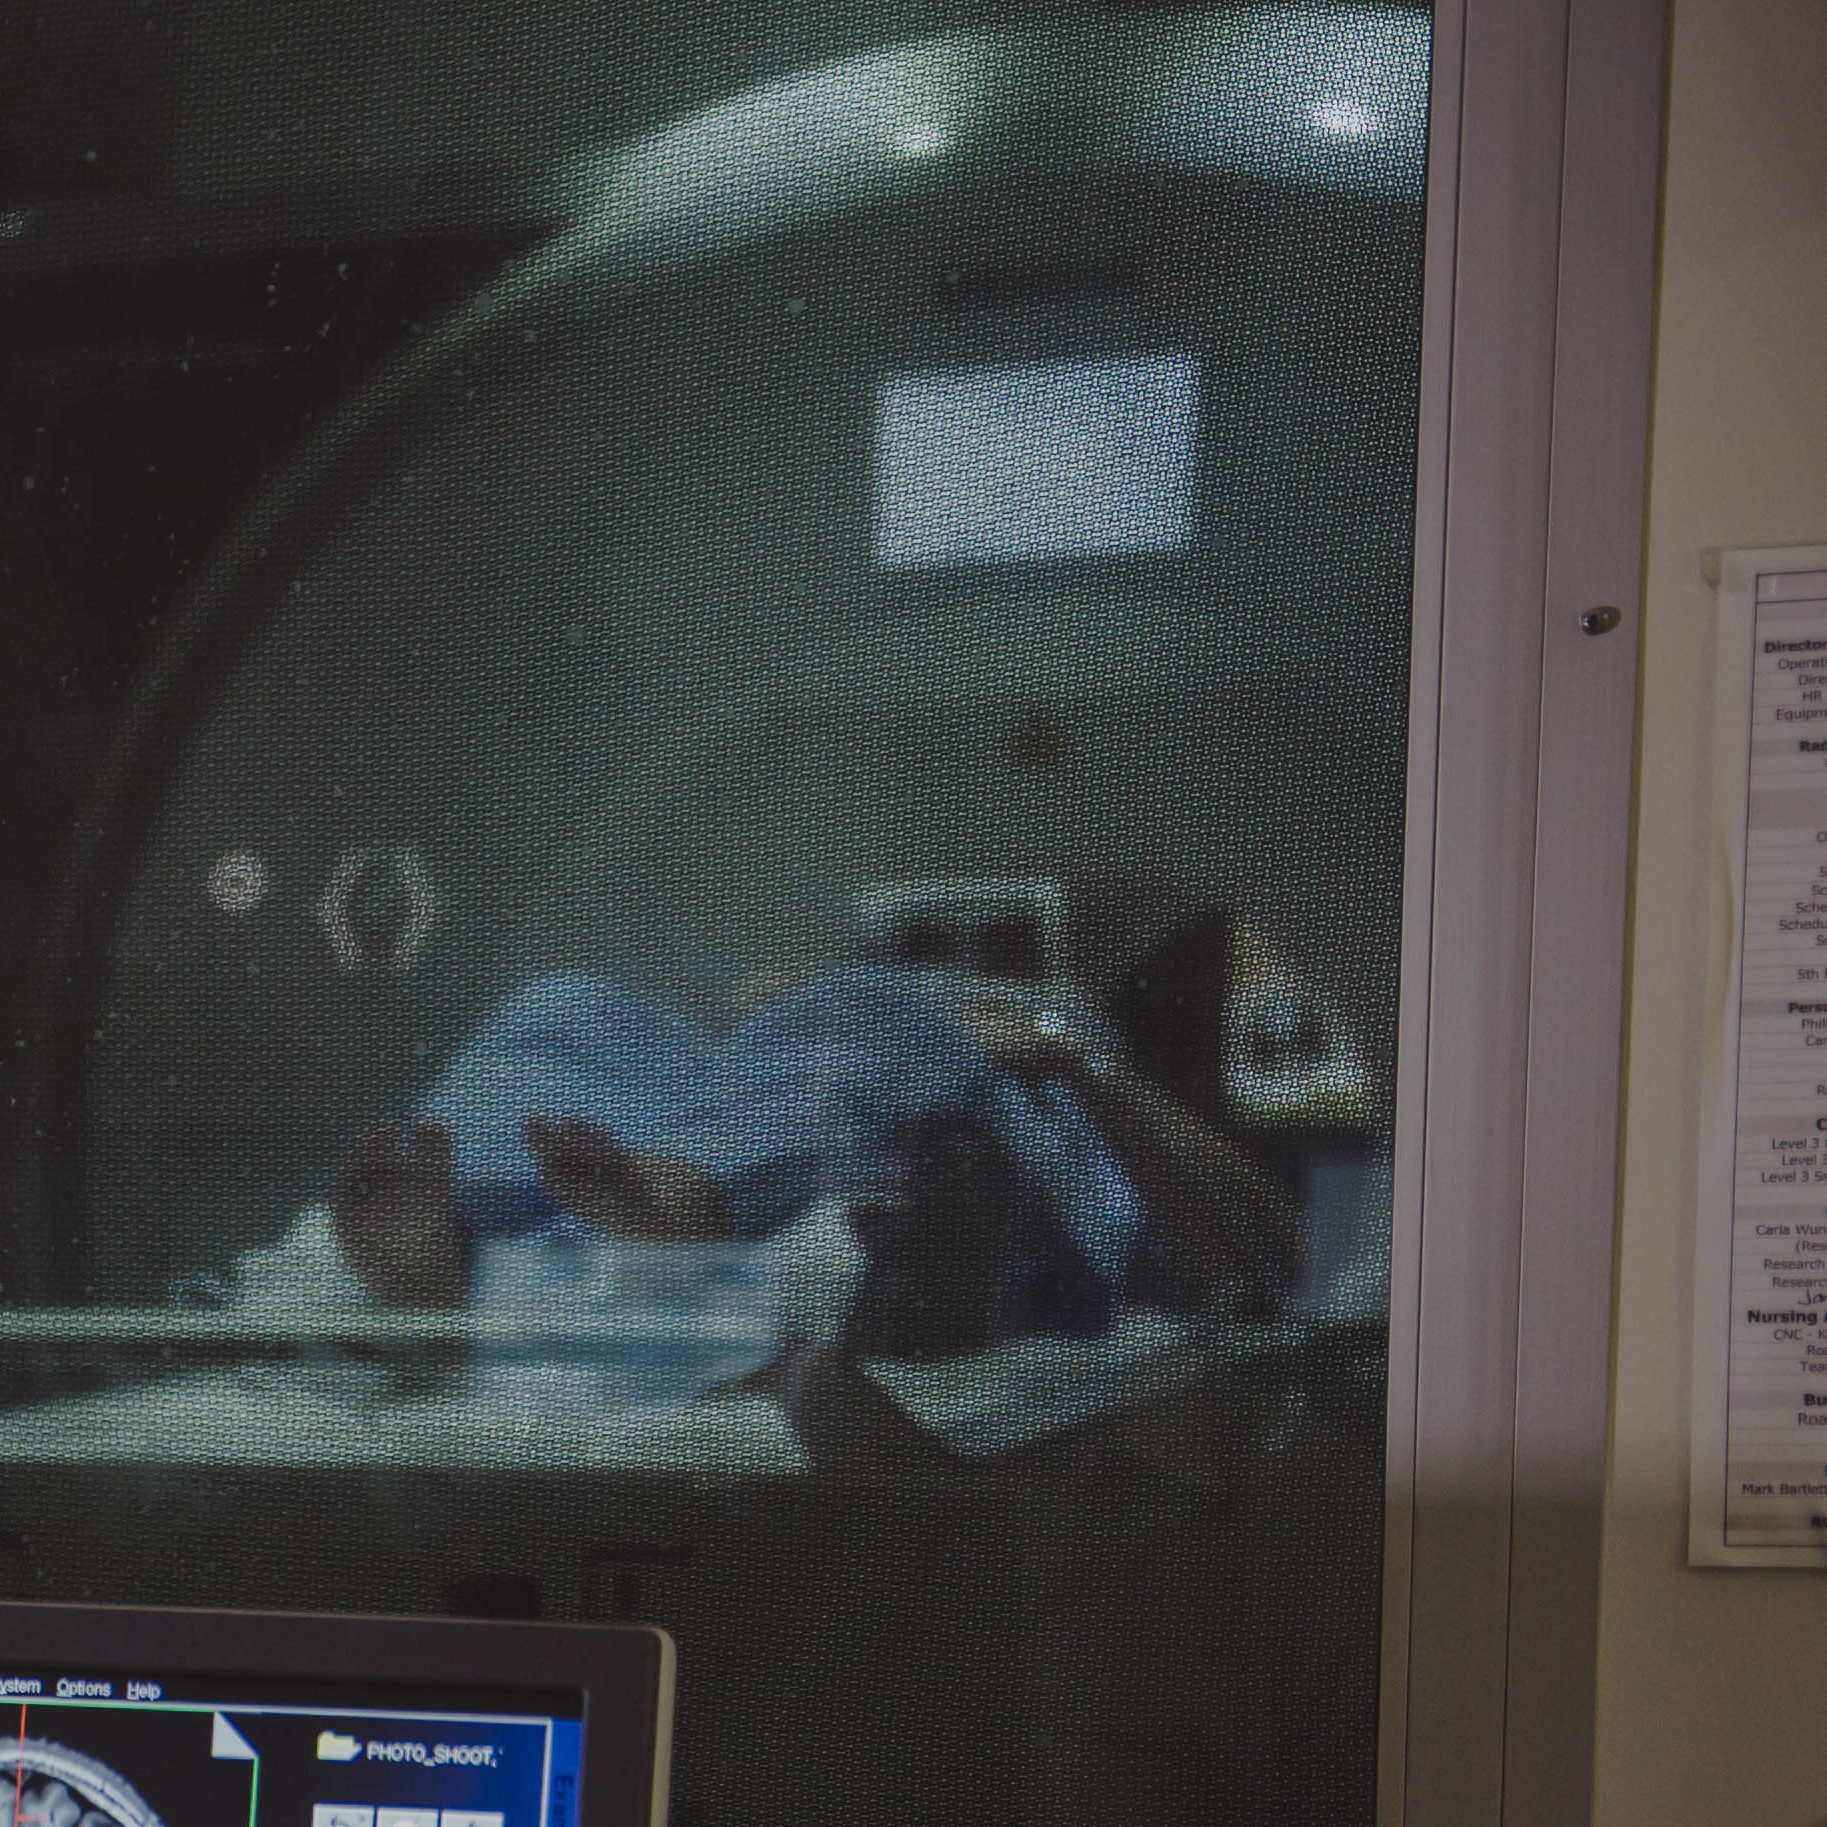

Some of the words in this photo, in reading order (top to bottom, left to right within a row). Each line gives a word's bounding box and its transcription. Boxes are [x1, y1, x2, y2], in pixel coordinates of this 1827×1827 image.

[1772, 1137, 1807, 1150] Level
[1782, 1154, 1817, 1166] Level
[1761, 1171, 1796, 1184] Level
[1764, 1258, 1825, 1270] Research
[1747, 1309, 1818, 1326] Nursing
[1742, 1483, 1776, 1495] Mark
[56, 1677, 112, 1698] Options
[126, 1680, 162, 1701] Help
